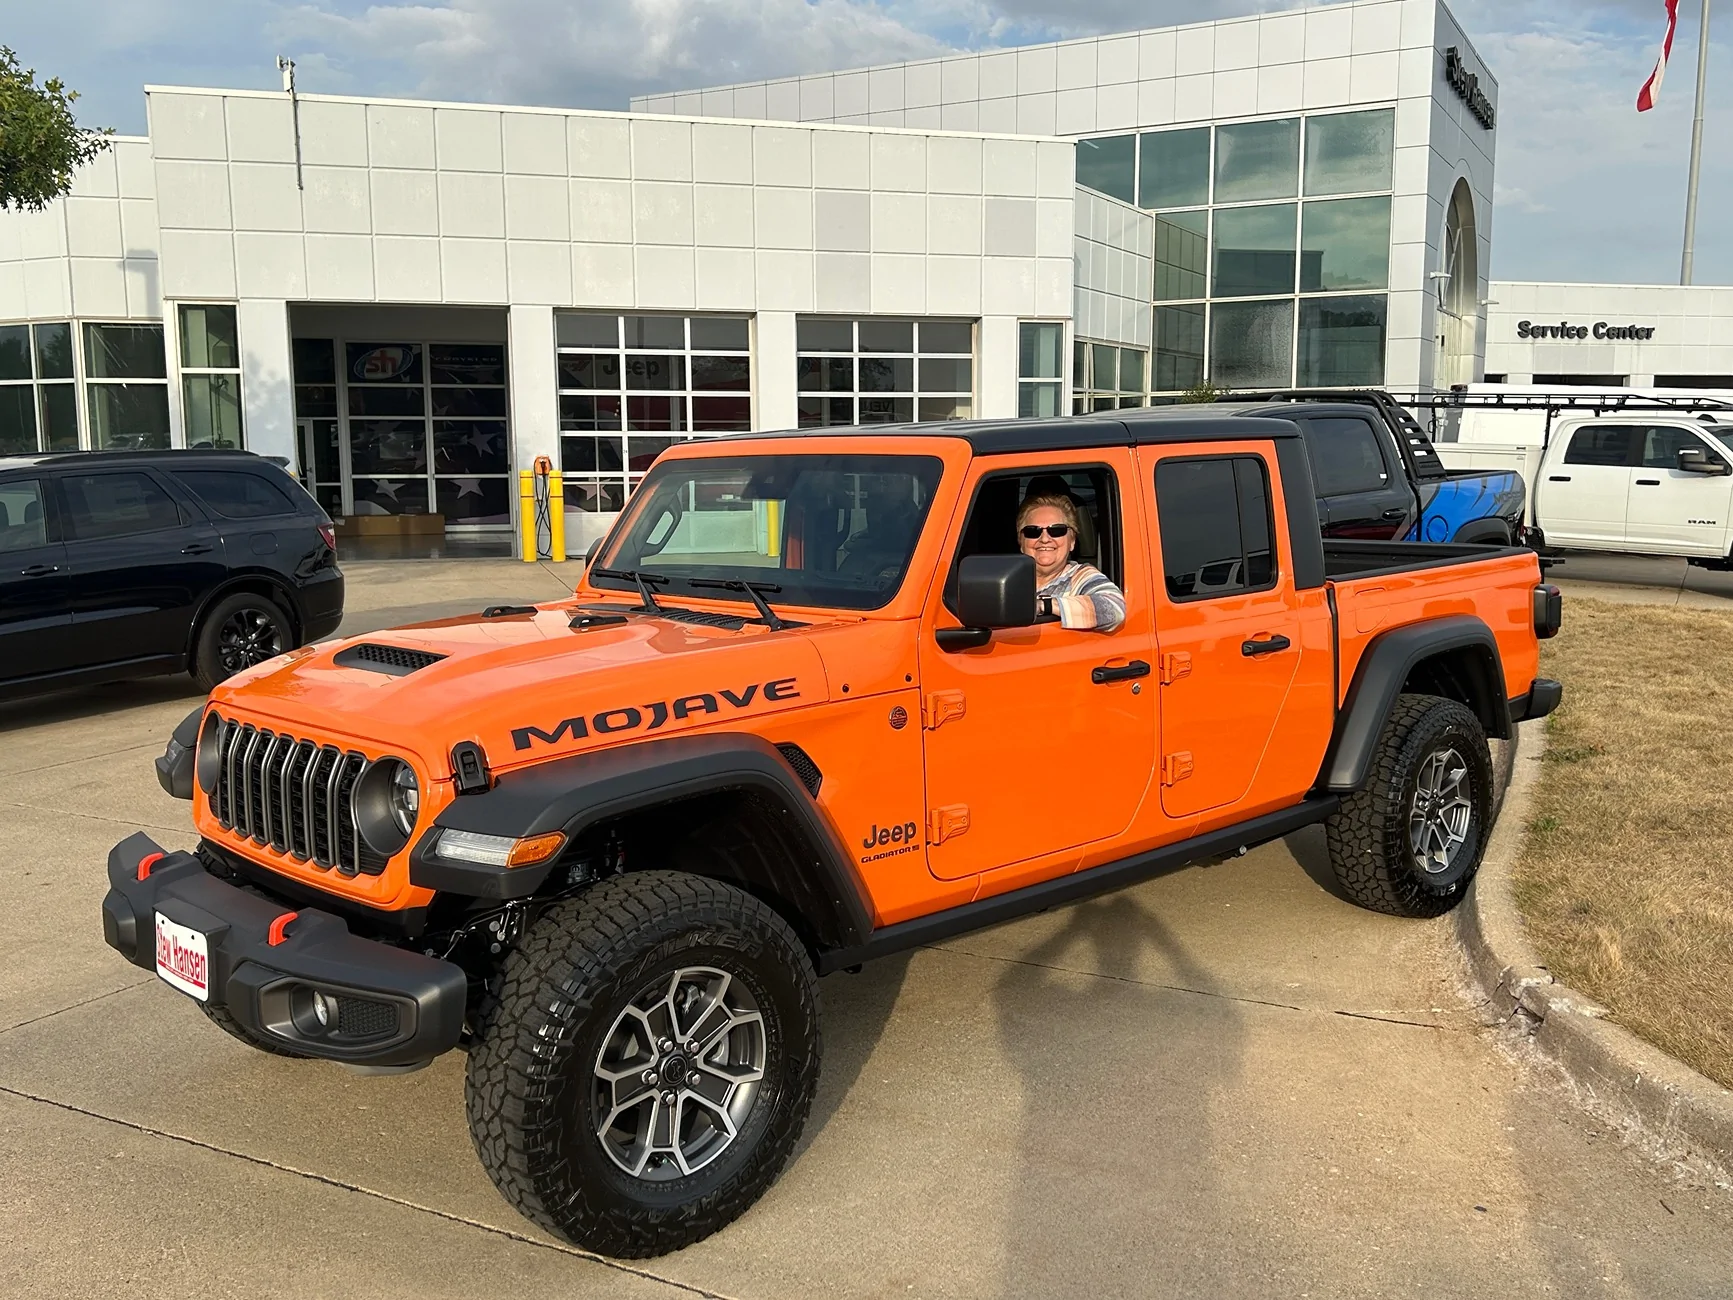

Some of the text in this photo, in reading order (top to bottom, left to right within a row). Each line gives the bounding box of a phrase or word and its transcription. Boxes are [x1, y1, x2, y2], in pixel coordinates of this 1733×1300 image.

[1517, 320, 1655, 340] Service Center
[510, 677, 801, 751] MOJAVE
[863, 821, 917, 849] Jeep
[861, 846, 911, 863] GLADIATOR
[156, 923, 171, 966] Stew
[172, 934, 206, 983] Hansen
